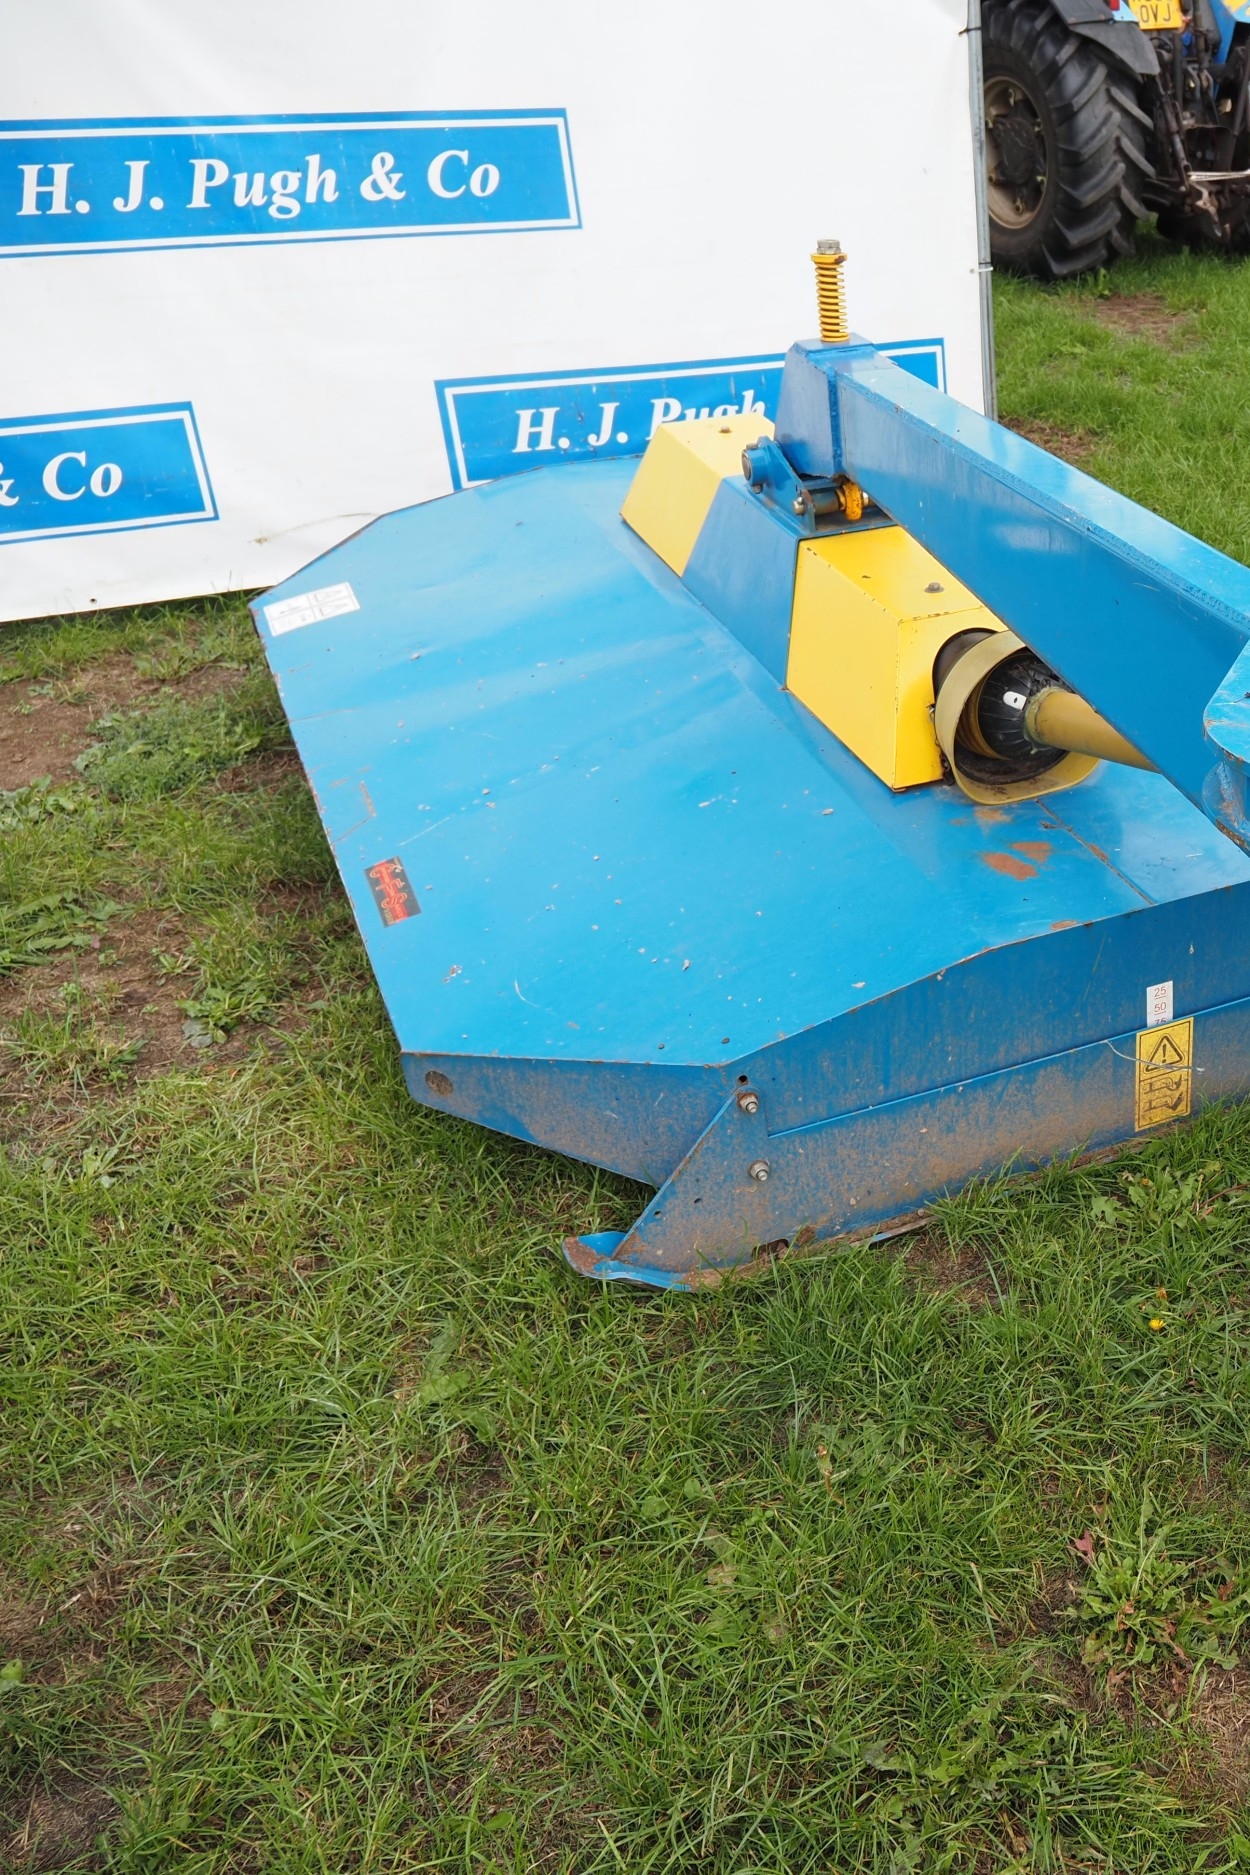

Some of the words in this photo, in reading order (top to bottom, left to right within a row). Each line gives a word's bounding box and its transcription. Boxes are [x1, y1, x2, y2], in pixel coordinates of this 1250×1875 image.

[1140, 4, 1172, 23] OVJ
[16, 163, 90, 216] H.
[113, 160, 164, 212] J.
[186, 153, 339, 219] Pugh
[360, 151, 406, 201] &
[427, 149, 500, 198] Co
[512, 407, 571, 453] H.
[587, 402, 629, 447] J.
[42, 450, 122, 501] Co
[1154, 986, 1167, 998] 25
[1154, 1001, 1167, 1013] 50
